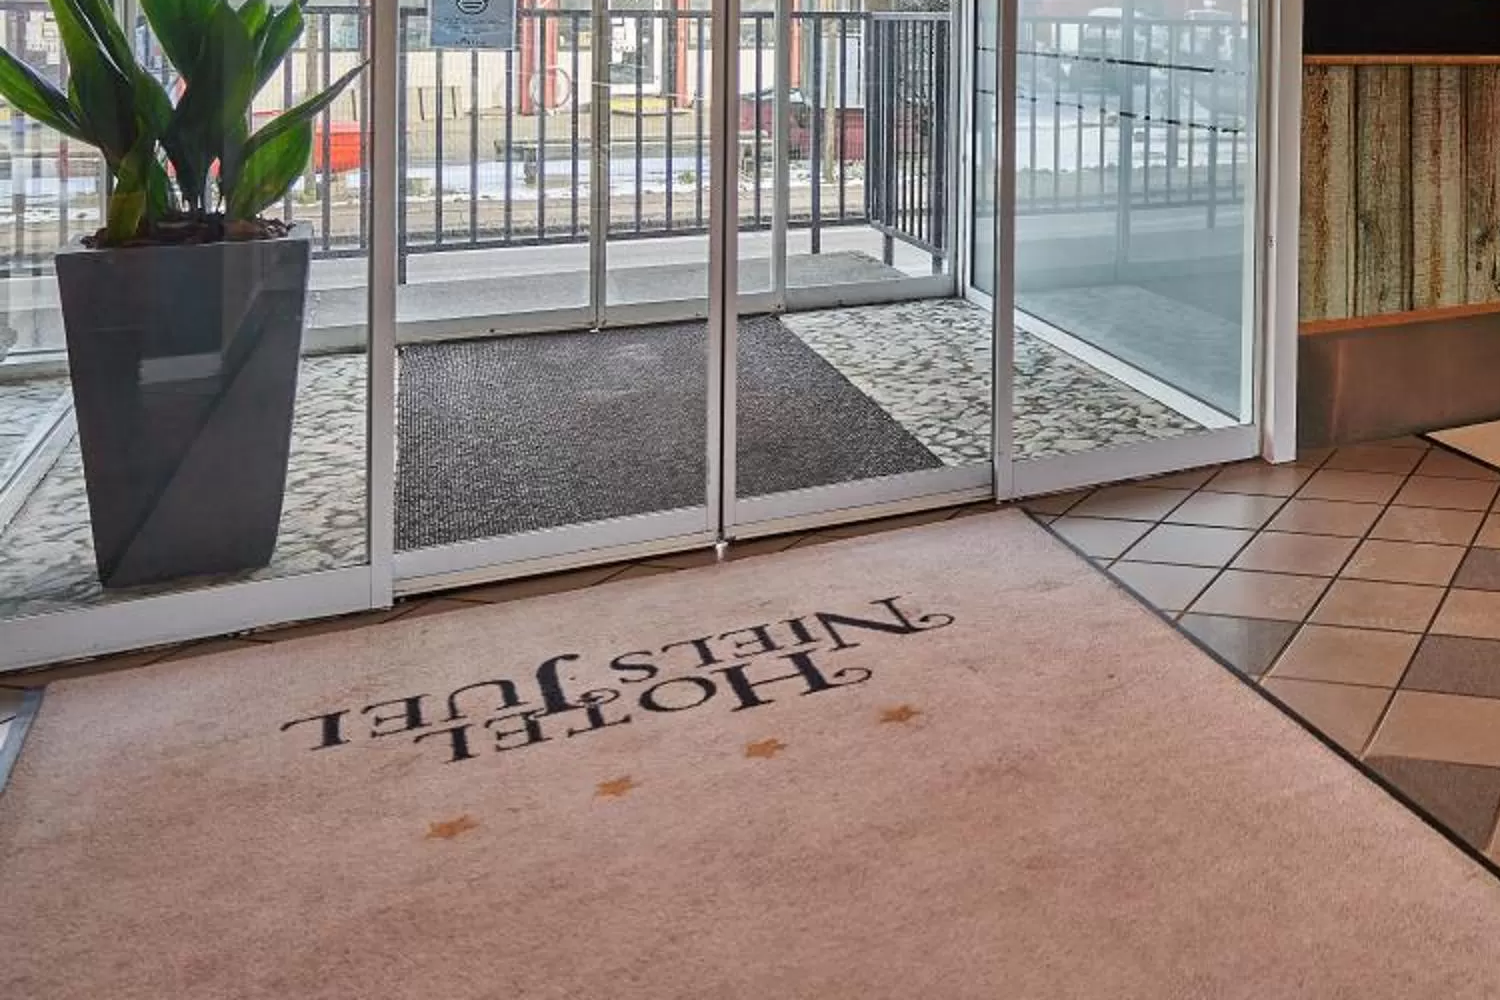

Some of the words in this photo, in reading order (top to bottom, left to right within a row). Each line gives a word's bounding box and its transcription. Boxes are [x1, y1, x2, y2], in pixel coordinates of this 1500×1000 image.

[610, 596, 955, 684] NIELS
[280, 653, 620, 750] JUEL
[415, 649, 873, 764] HOTEL
